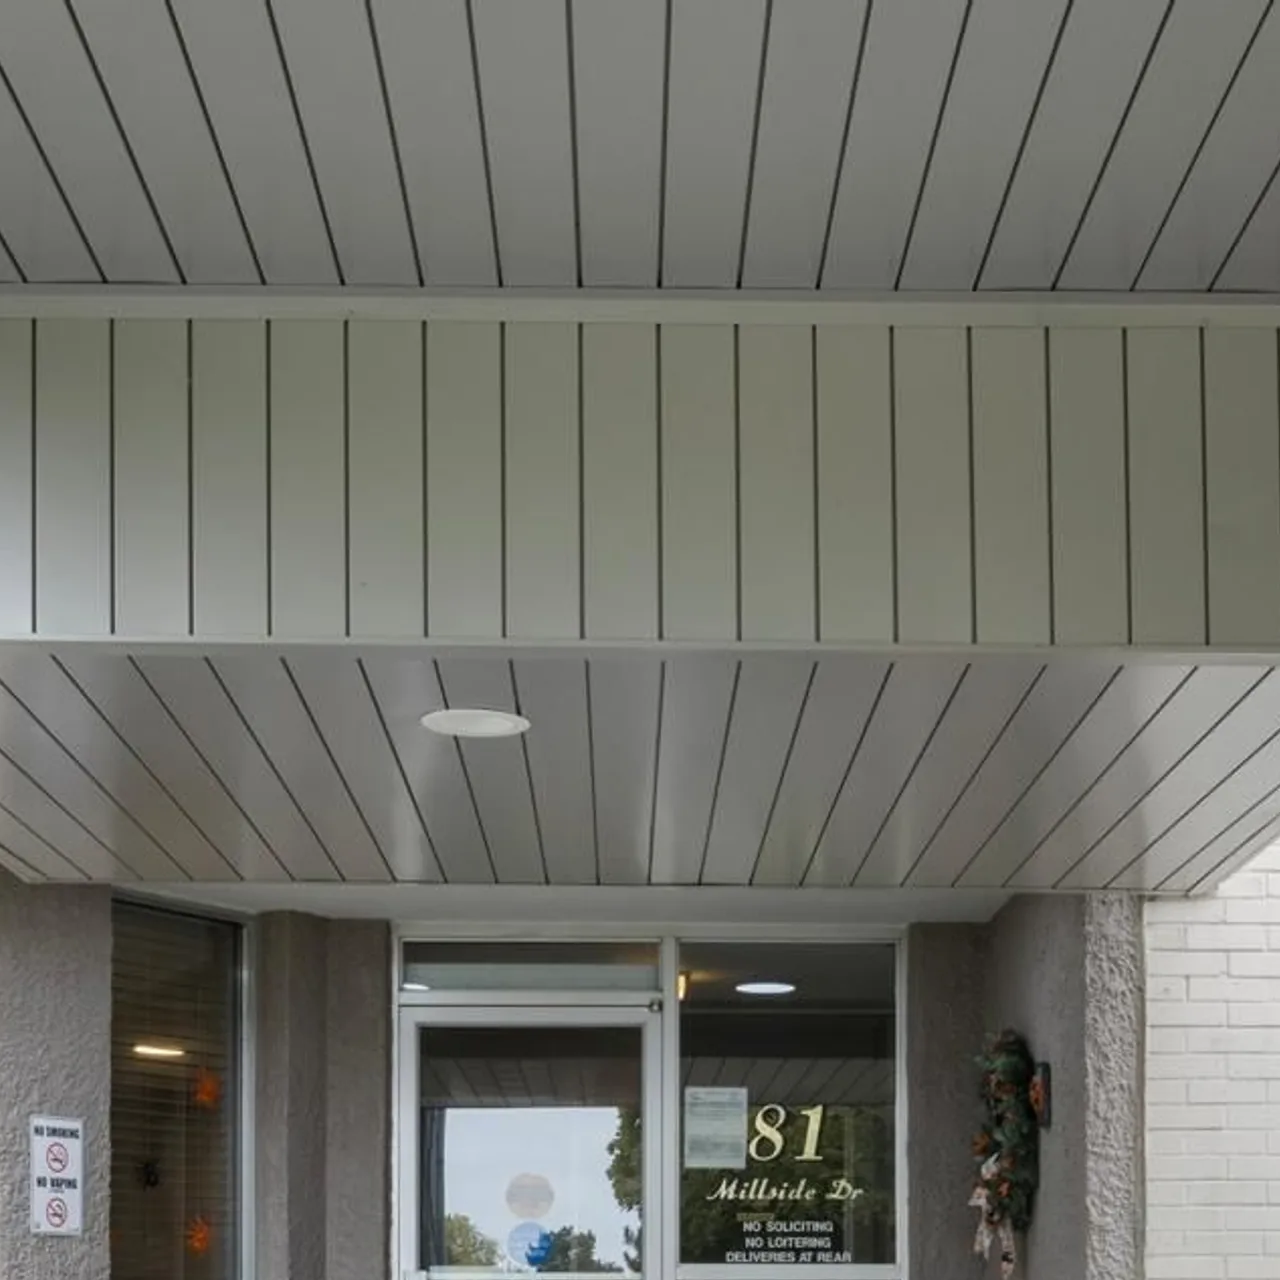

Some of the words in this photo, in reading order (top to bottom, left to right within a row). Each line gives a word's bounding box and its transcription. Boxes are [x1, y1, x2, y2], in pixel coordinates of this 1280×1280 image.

[33, 1125, 45, 1136] NO
[46, 1126, 80, 1139] SMOKING
[748, 1103, 824, 1162] 81
[36, 1176, 47, 1187] NO
[50, 1177, 78, 1190] VAPING
[706, 1178, 817, 1201] Millside
[826, 1179, 864, 1201] Dr
[743, 1221, 761, 1232] NO
[766, 1221, 833, 1232] SOLICITING
[745, 1237, 762, 1248] NO
[767, 1237, 831, 1248] LOITERING
[726, 1252, 795, 1263] DELIVERIES
[800, 1252, 813, 1263] AT
[817, 1252, 852, 1263] REAR
